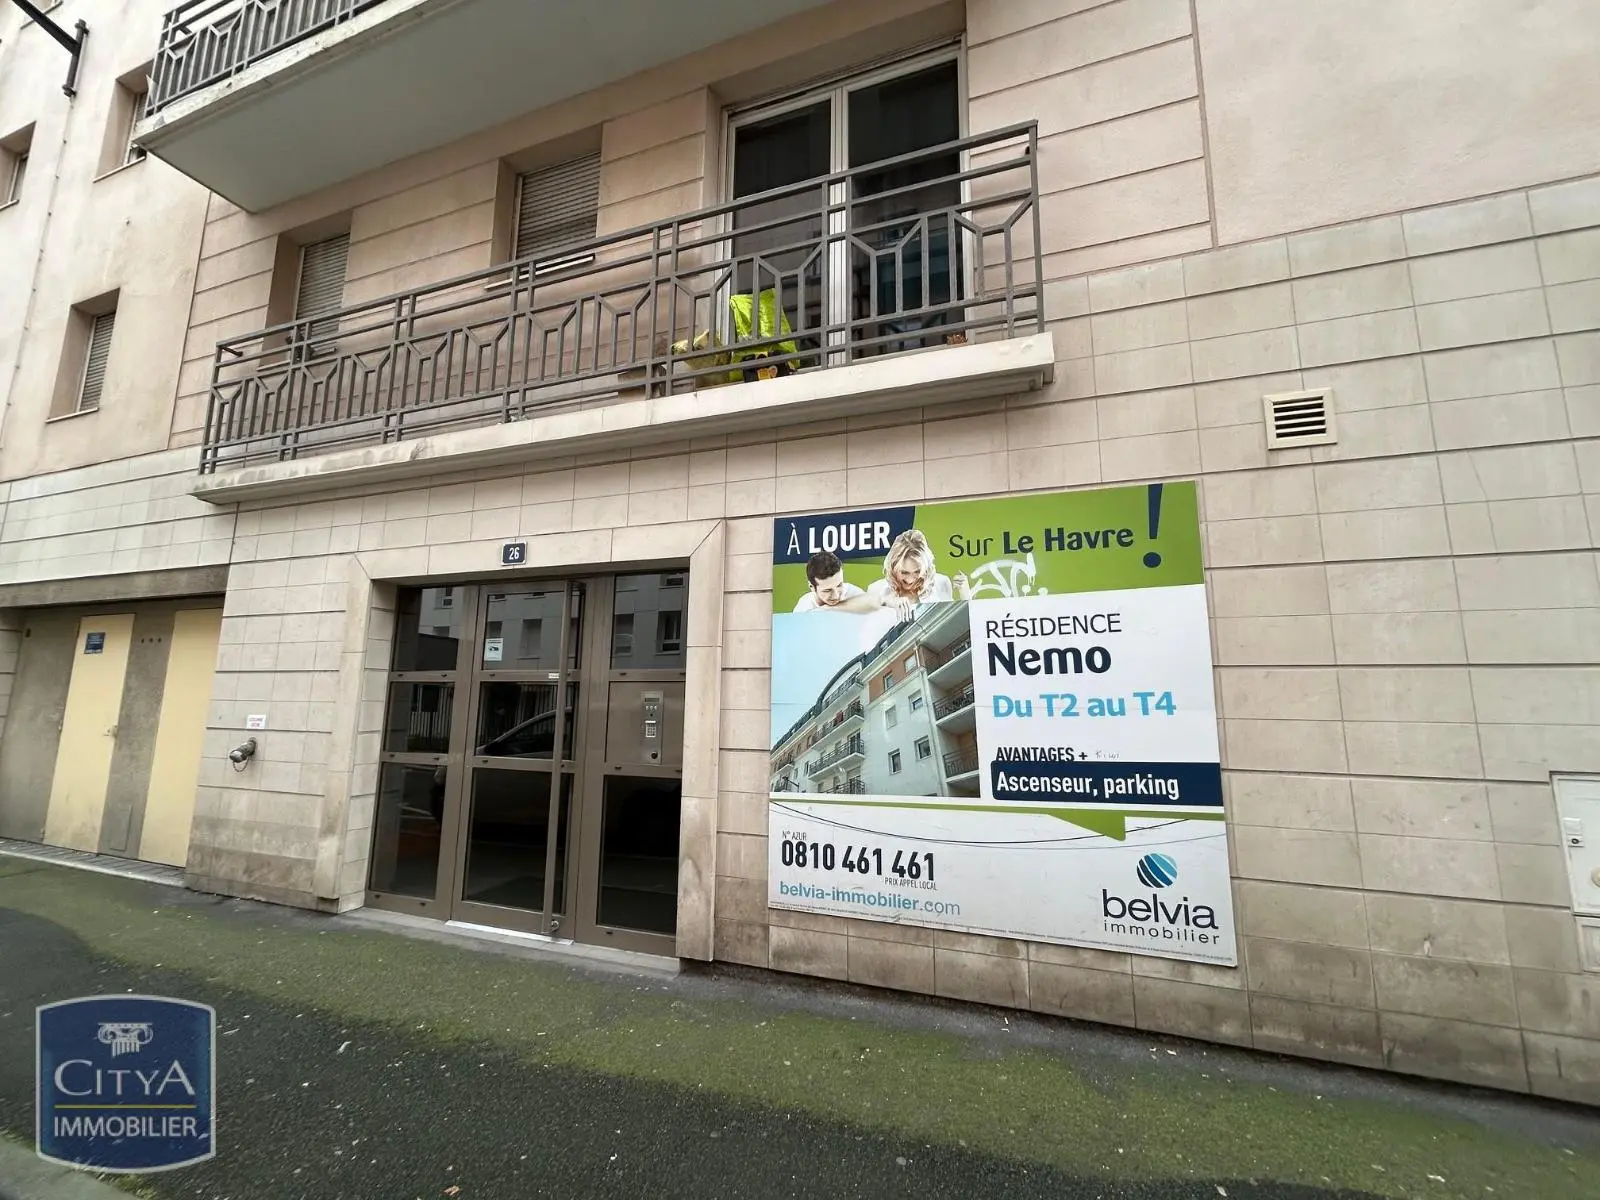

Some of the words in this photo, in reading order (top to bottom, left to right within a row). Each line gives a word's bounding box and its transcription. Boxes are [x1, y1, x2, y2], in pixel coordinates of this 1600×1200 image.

[786, 522, 801, 556] À
[808, 521, 891, 554] LOUER
[949, 534, 994, 558] Sur
[1003, 531, 1034, 554] Le
[1044, 527, 1134, 552] Havre
[508, 546, 520, 560] 26
[986, 613, 1122, 638] RÉSIDENCE
[987, 641, 1112, 676] Nemo
[992, 695, 1033, 718] Du
[1039, 693, 1080, 718] T2
[1087, 697, 1126, 717] au
[1132, 691, 1177, 716] T4
[995, 747, 1075, 762] AVANTAGES
[996, 771, 1098, 797] Ascenseur,
[1103, 774, 1180, 800] parking
[791, 831, 807, 841] AZUR
[781, 839, 835, 871] 0810
[842, 845, 883, 876] 461
[891, 850, 935, 881] 461
[884, 877, 898, 887] PRIX
[899, 878, 919, 889] APPEL
[919, 881, 938, 891] LOCAL
[779, 881, 961, 916] belvia-immobilier.com
[1102, 888, 1219, 930] belvia
[1104, 920, 1220, 944] immobilier
